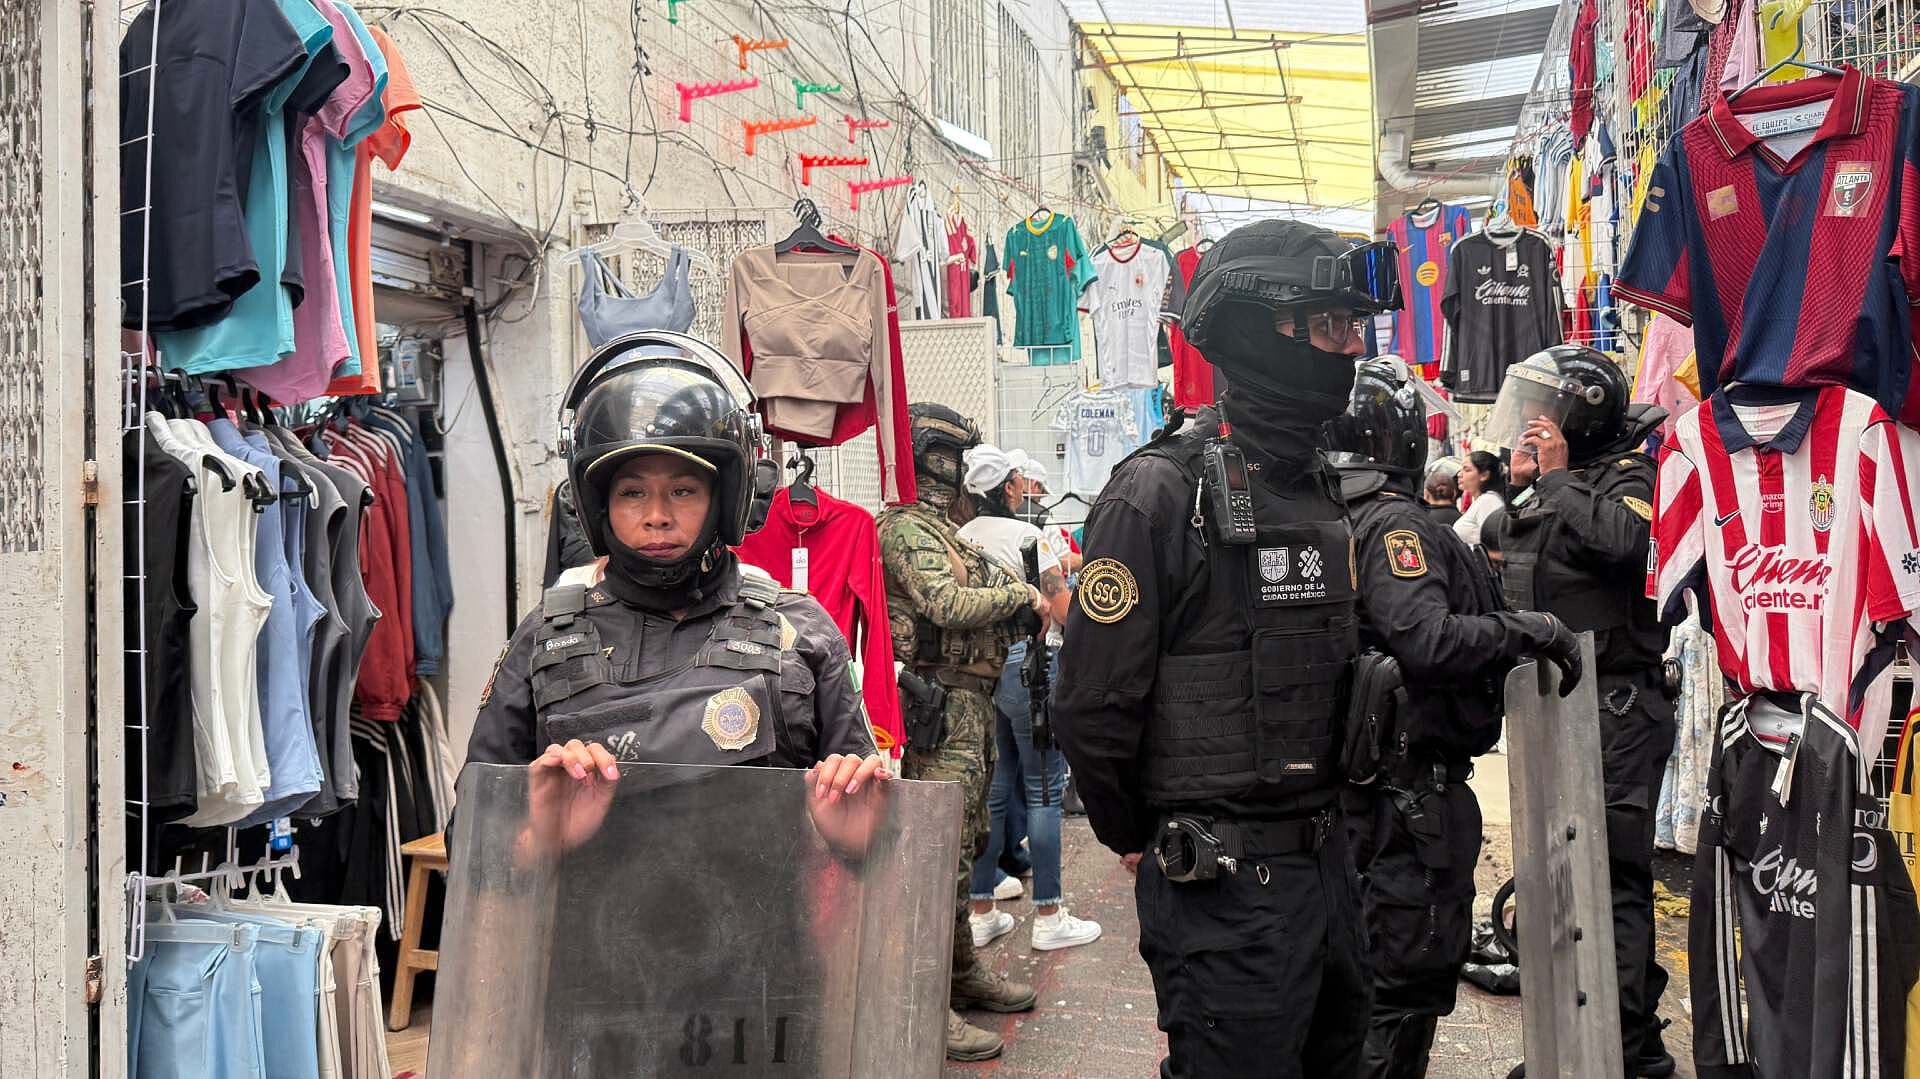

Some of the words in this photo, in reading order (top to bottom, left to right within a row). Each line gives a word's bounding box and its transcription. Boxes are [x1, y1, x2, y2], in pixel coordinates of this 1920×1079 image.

[1081, 407, 1115, 418] COLEMAN
[1261, 584, 1303, 593] GOBIERNO
[1316, 582, 1326, 590] LA
[1093, 581, 1121, 606] SSC
[1289, 592, 1300, 600] DE
[1300, 591, 1326, 600] MÉXICO
[679, 1014, 788, 1067] 811
